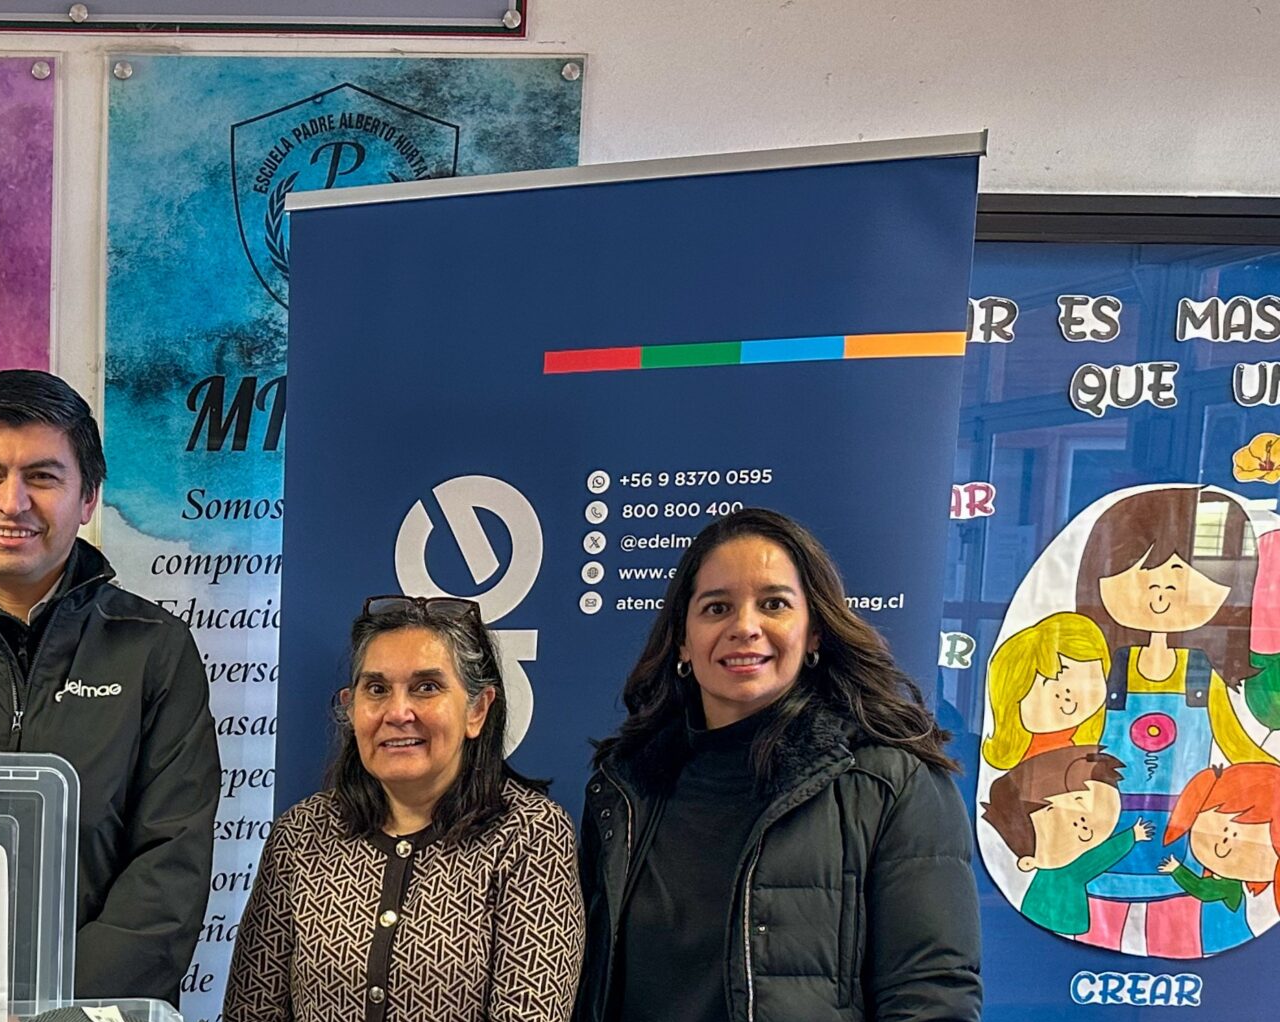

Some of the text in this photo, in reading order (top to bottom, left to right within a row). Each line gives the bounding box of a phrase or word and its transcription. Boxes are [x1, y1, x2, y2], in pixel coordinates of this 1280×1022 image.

[253, 112, 432, 194] ESCUELA PADRE ALBERTO HURTA
[967, 296, 1280, 342] R ES MAS
[1071, 363, 1280, 417] QUE U
[619, 469, 773, 488] +56 9 8370 0595
[181, 488, 284, 520] Somos
[622, 501, 744, 519] 800 800 400
[620, 534, 698, 552] @edelm
[1070, 971, 1202, 1006] CREAR
